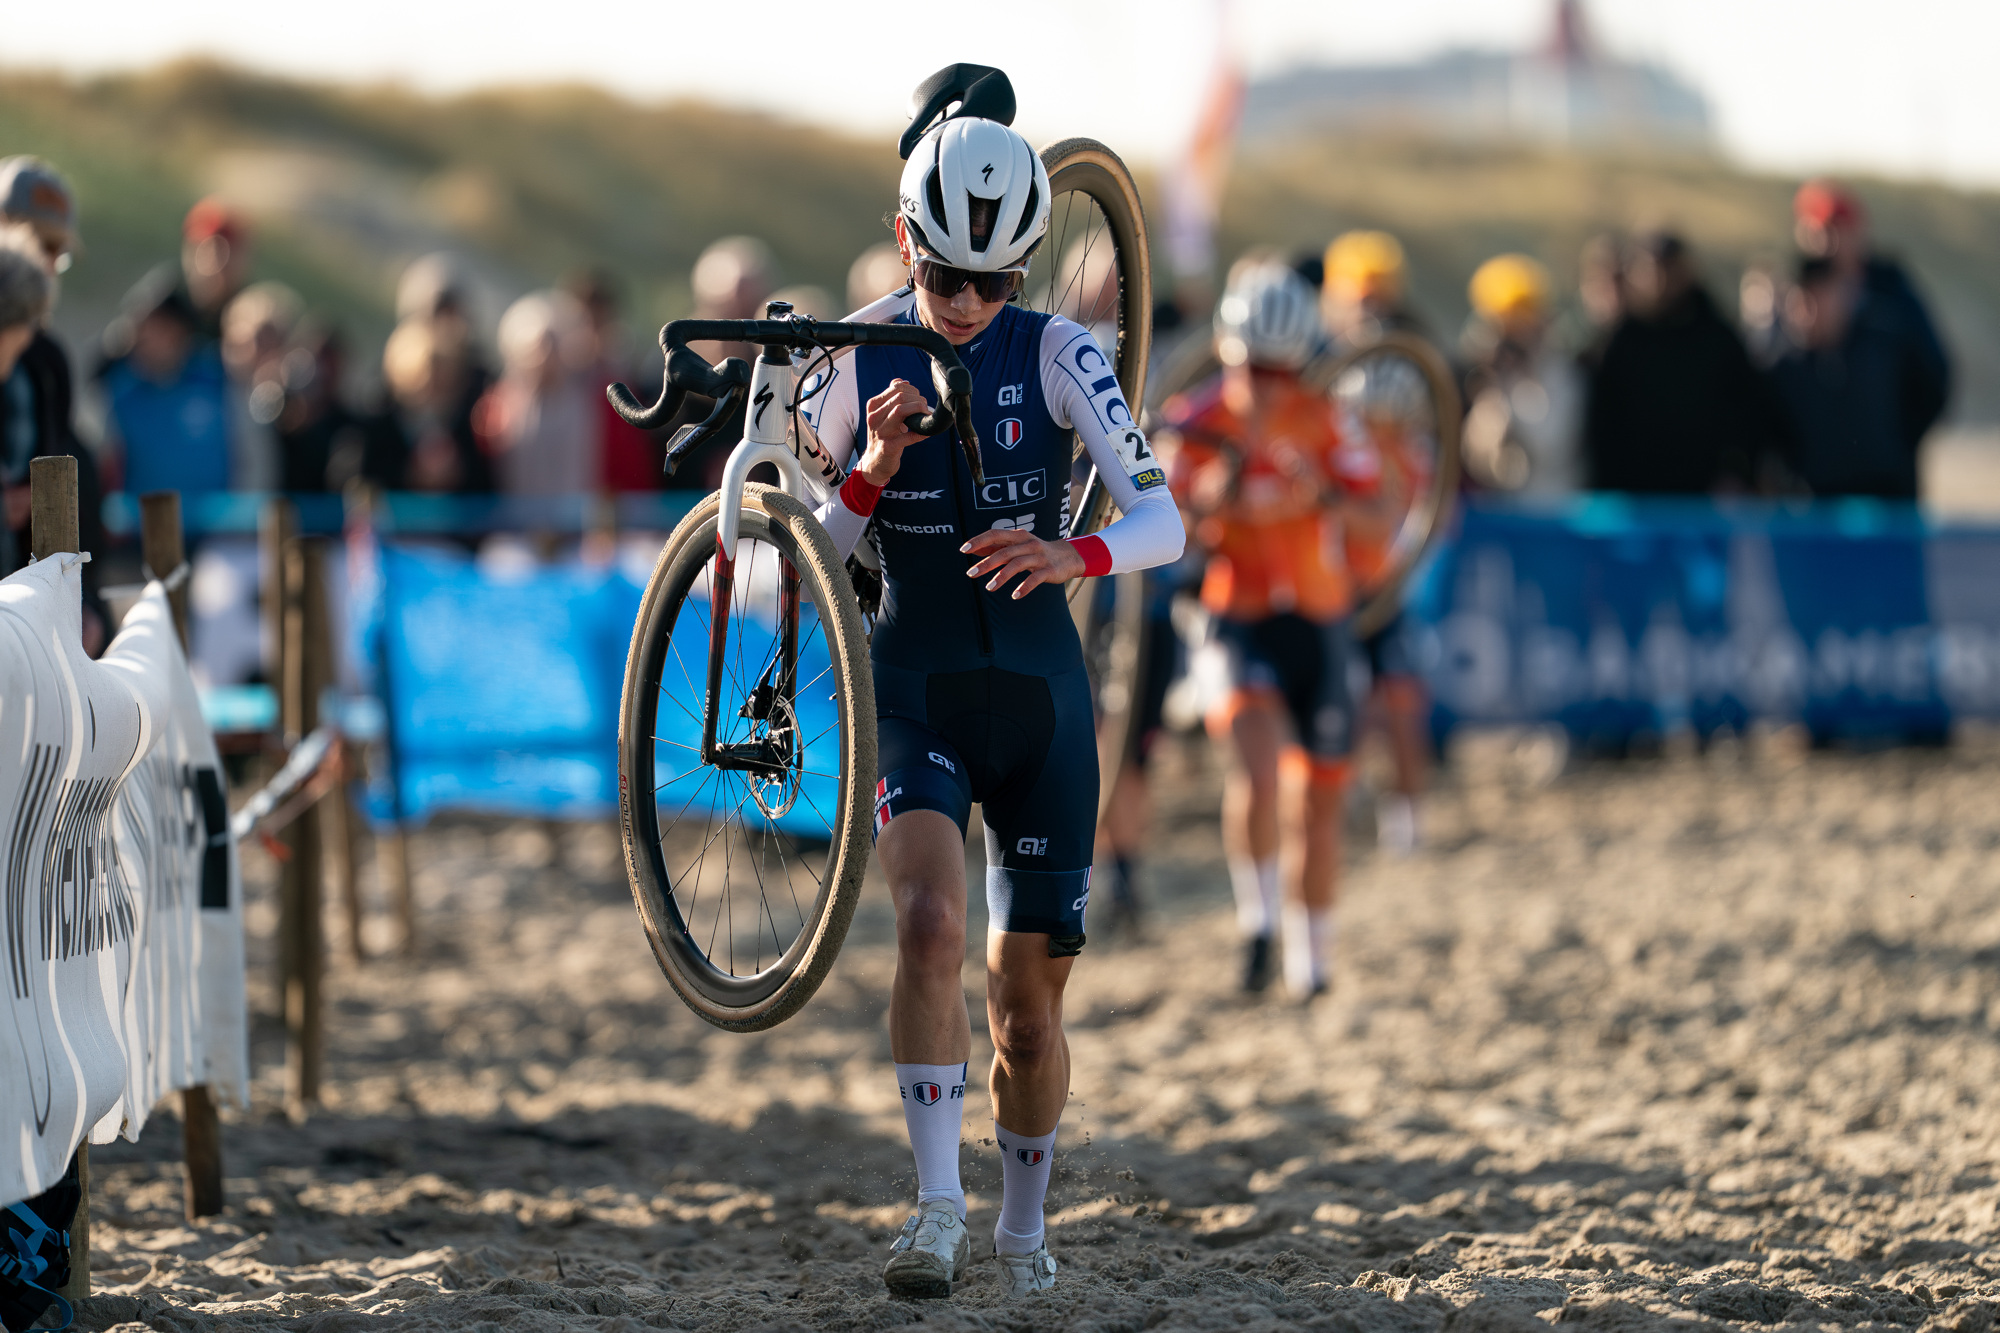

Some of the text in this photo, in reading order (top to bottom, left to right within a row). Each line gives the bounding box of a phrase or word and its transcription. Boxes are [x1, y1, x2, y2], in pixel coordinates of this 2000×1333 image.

[1075, 344, 1132, 426] CIC
[1124, 431, 1152, 462] 2
[981, 476, 1041, 503] CIC
[894, 523, 955, 534] FACOM
[621, 792, 633, 846] EDITION
